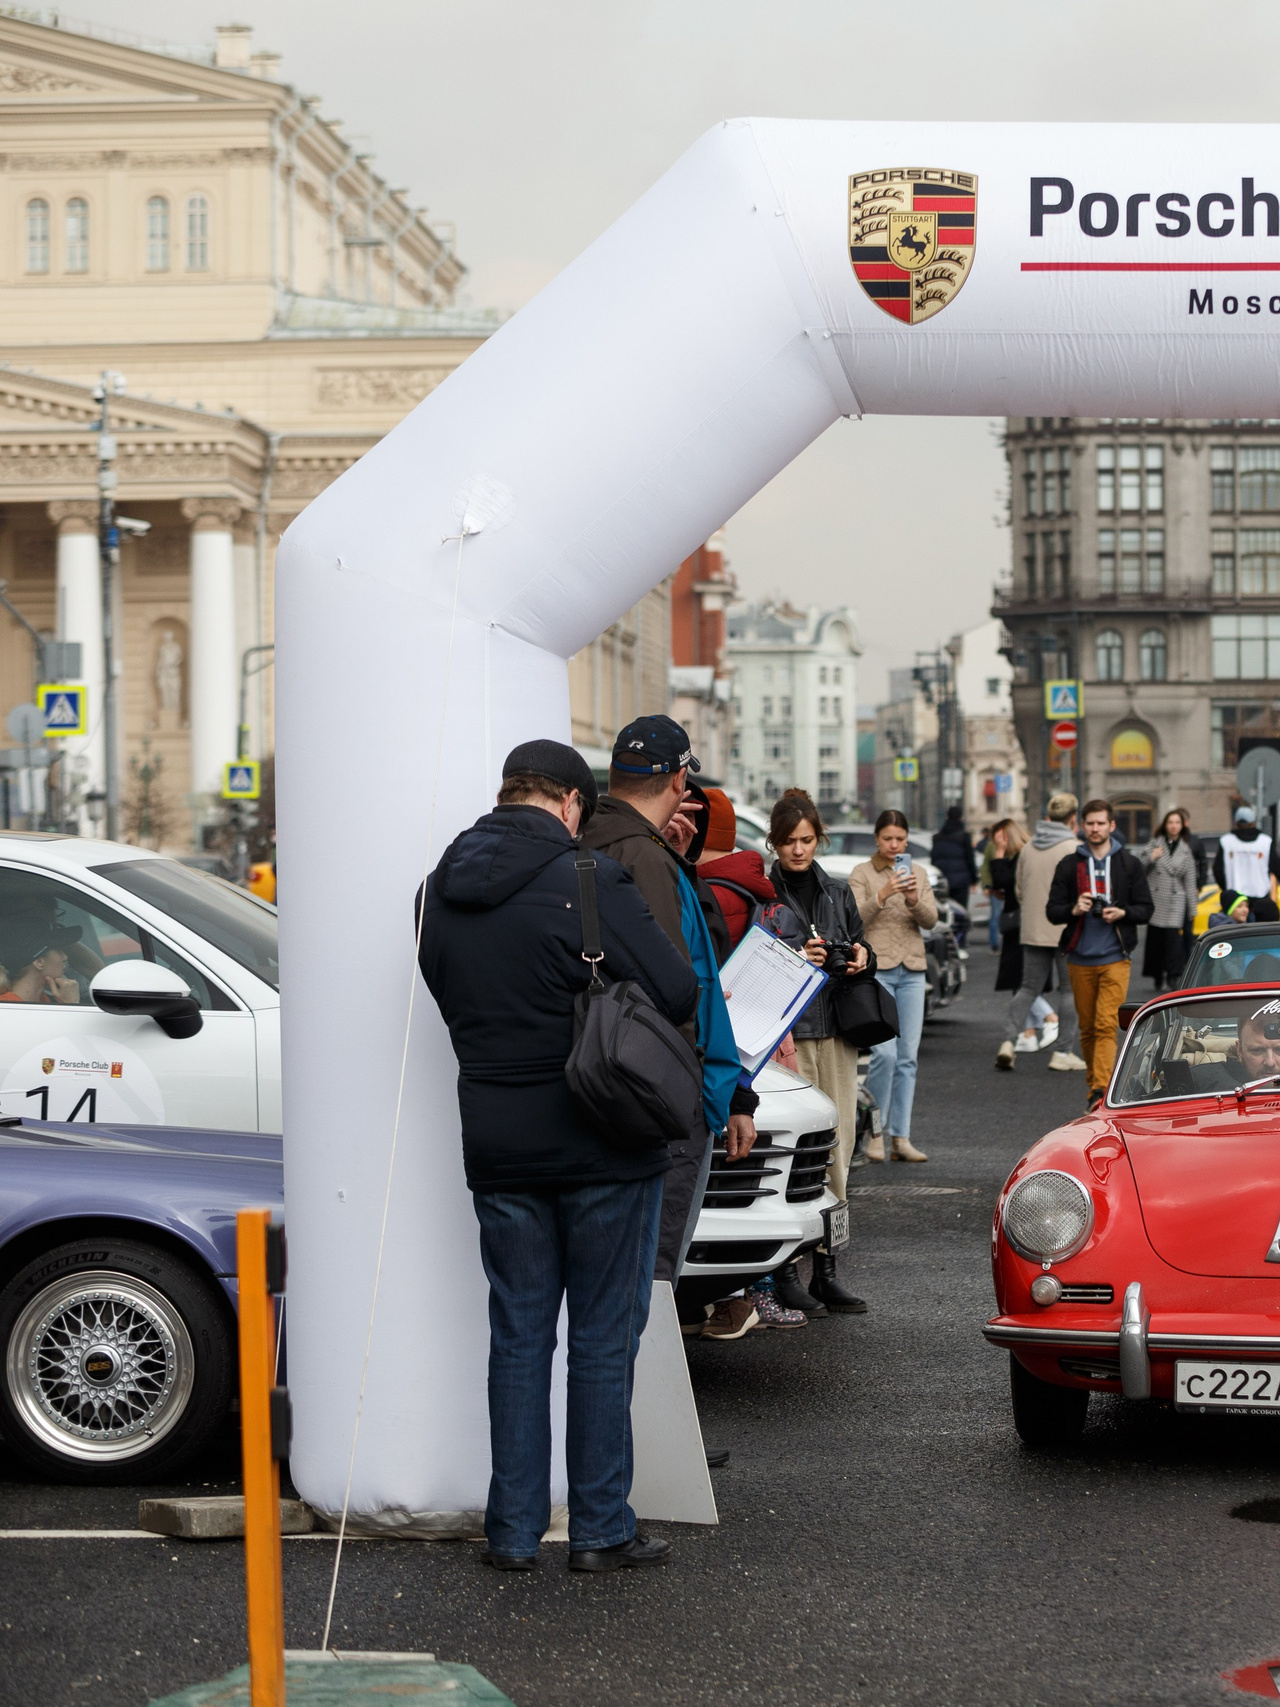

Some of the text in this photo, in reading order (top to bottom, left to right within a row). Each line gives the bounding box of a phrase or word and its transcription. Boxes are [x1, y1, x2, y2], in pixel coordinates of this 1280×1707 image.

[853, 169, 974, 188] PORSCHE
[892, 215, 933, 223] STUTTGART
[60, 1060, 109, 1070] Porsche Club
[26, 1086, 97, 1123] 14
[31, 1252, 104, 1283] MICHELIN
[88, 1361, 110, 1371] BBS
